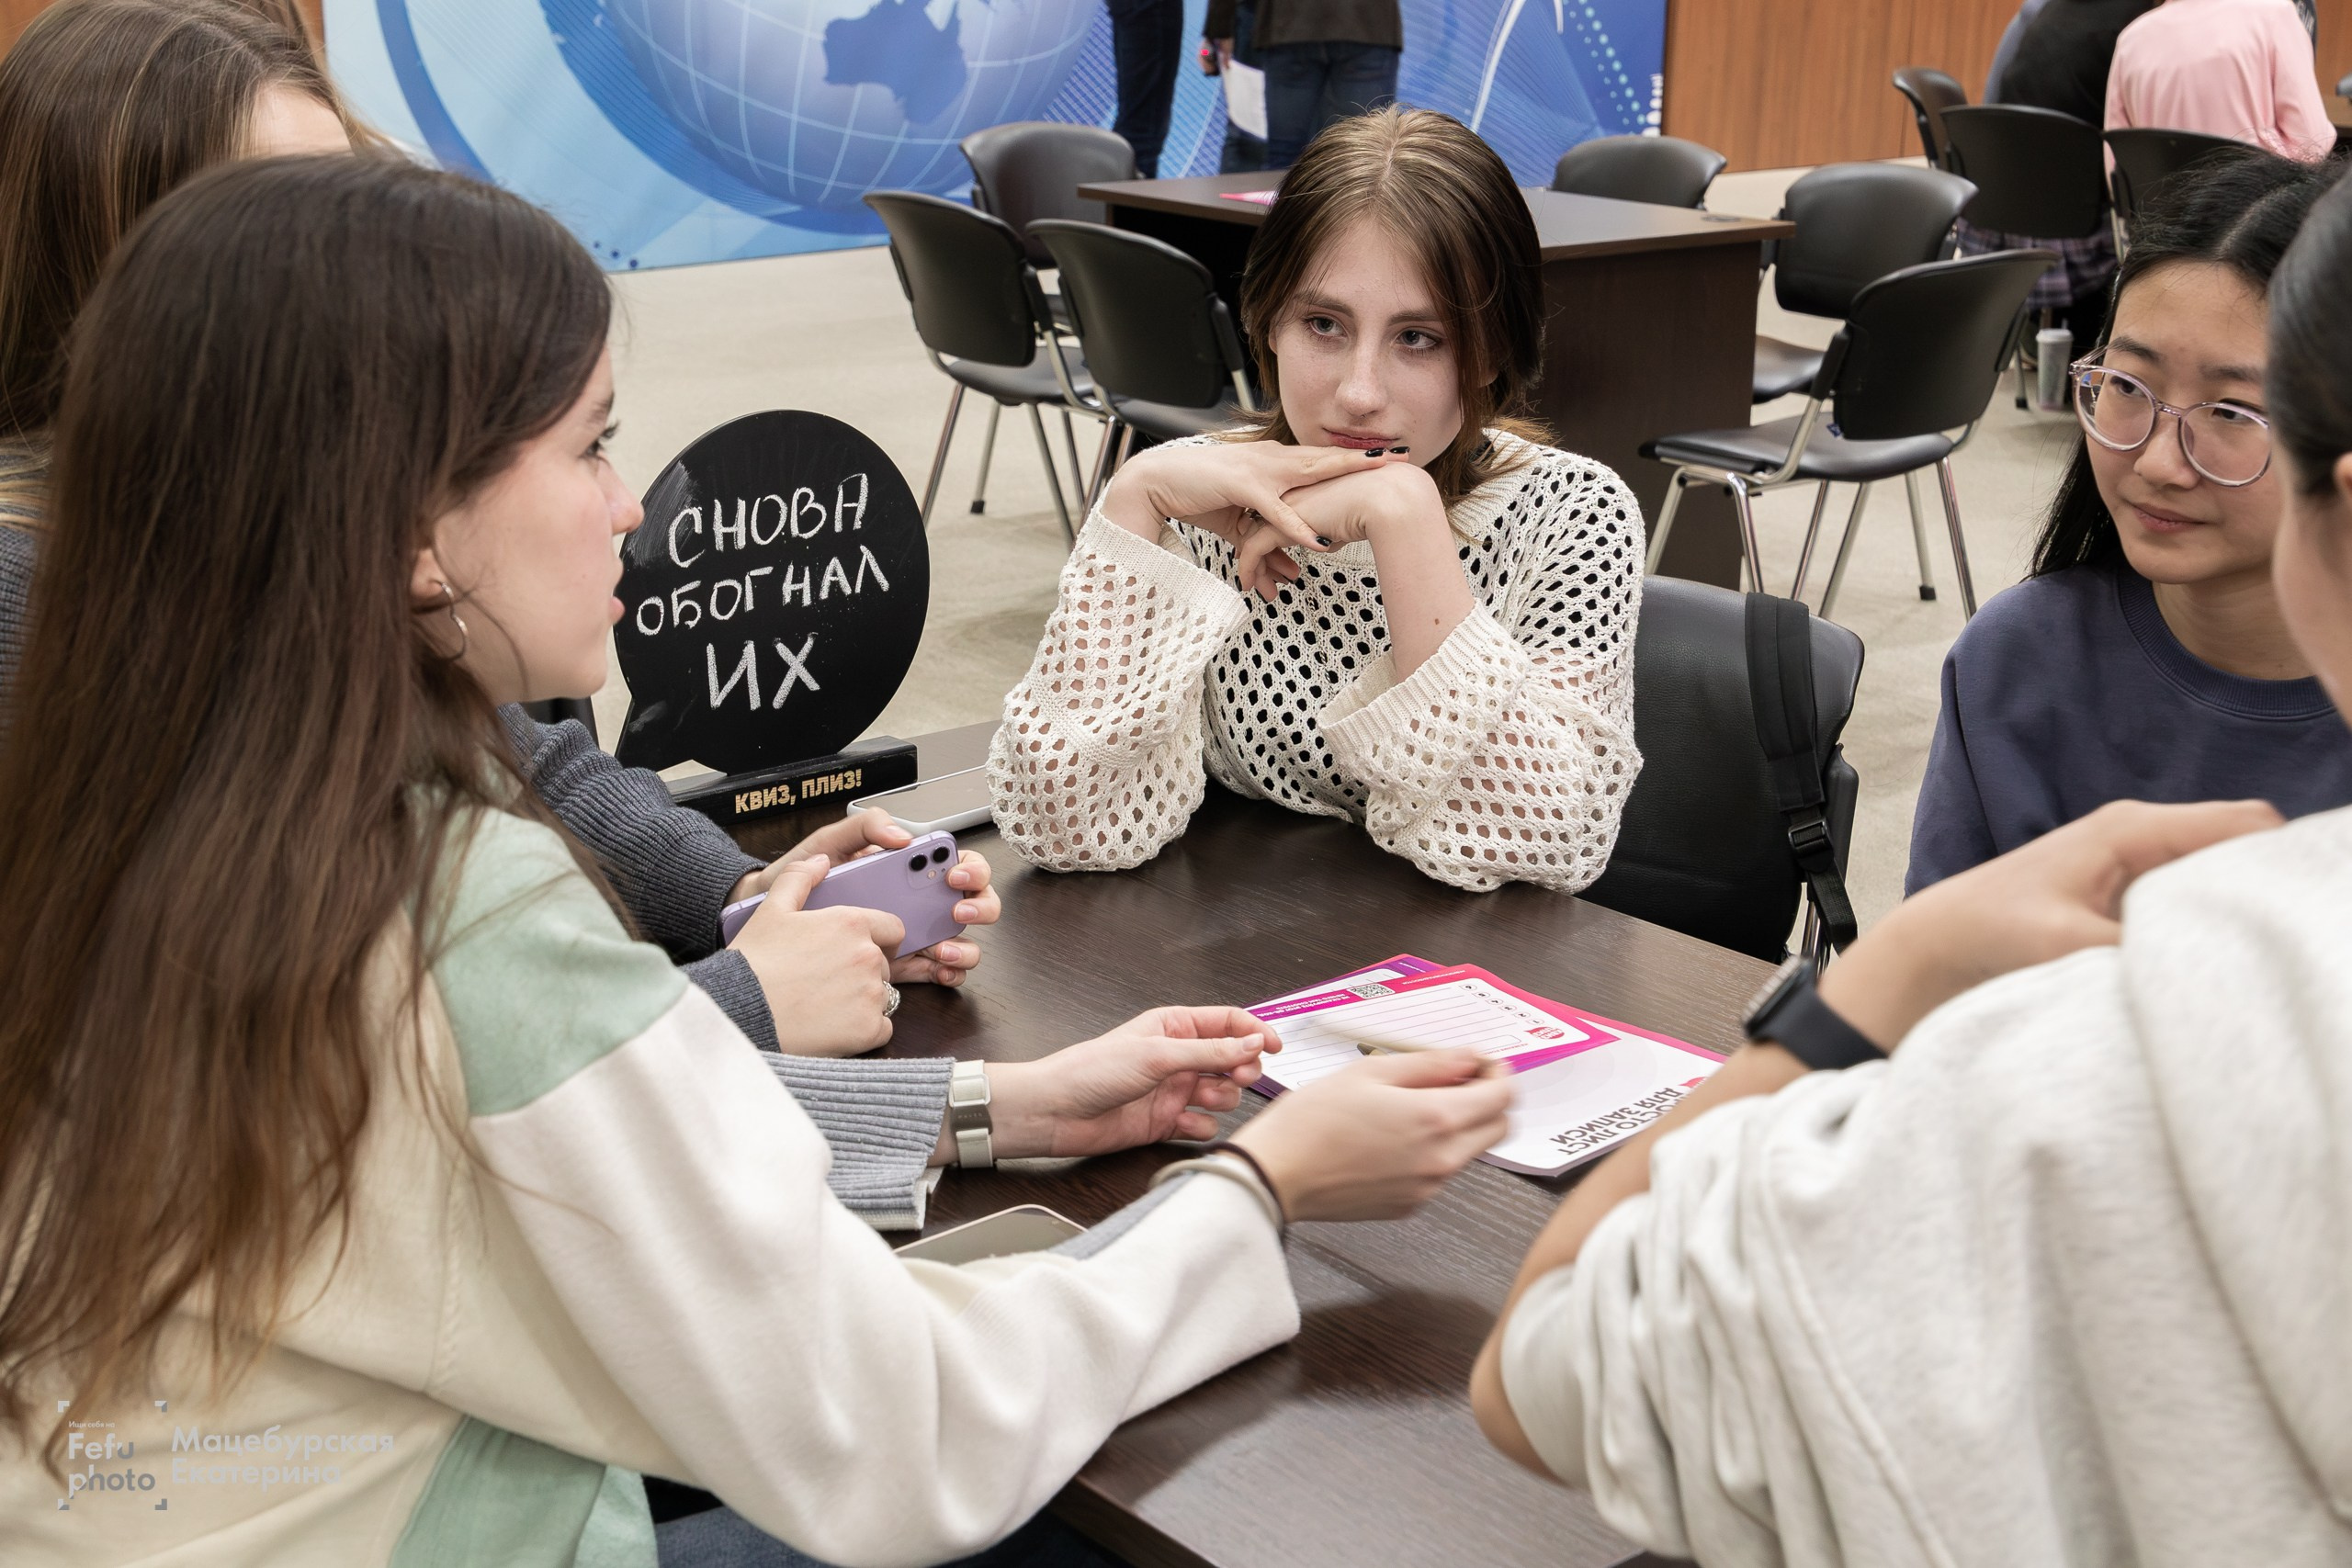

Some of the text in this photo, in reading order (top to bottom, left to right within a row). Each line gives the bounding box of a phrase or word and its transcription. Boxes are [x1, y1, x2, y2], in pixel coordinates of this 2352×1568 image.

[668, 472, 869, 568] СНОВА
[636, 545, 889, 636] ОБОГНАЛ
[706, 632, 820, 711] ИХ
[735, 768, 863, 814] КВИЗ, ПЛИЗ!
[1549, 1087, 1684, 1145] ДЛЯ ЗАПИСИ
[1557, 1096, 1687, 1155] ОСТО ЛИСТ
